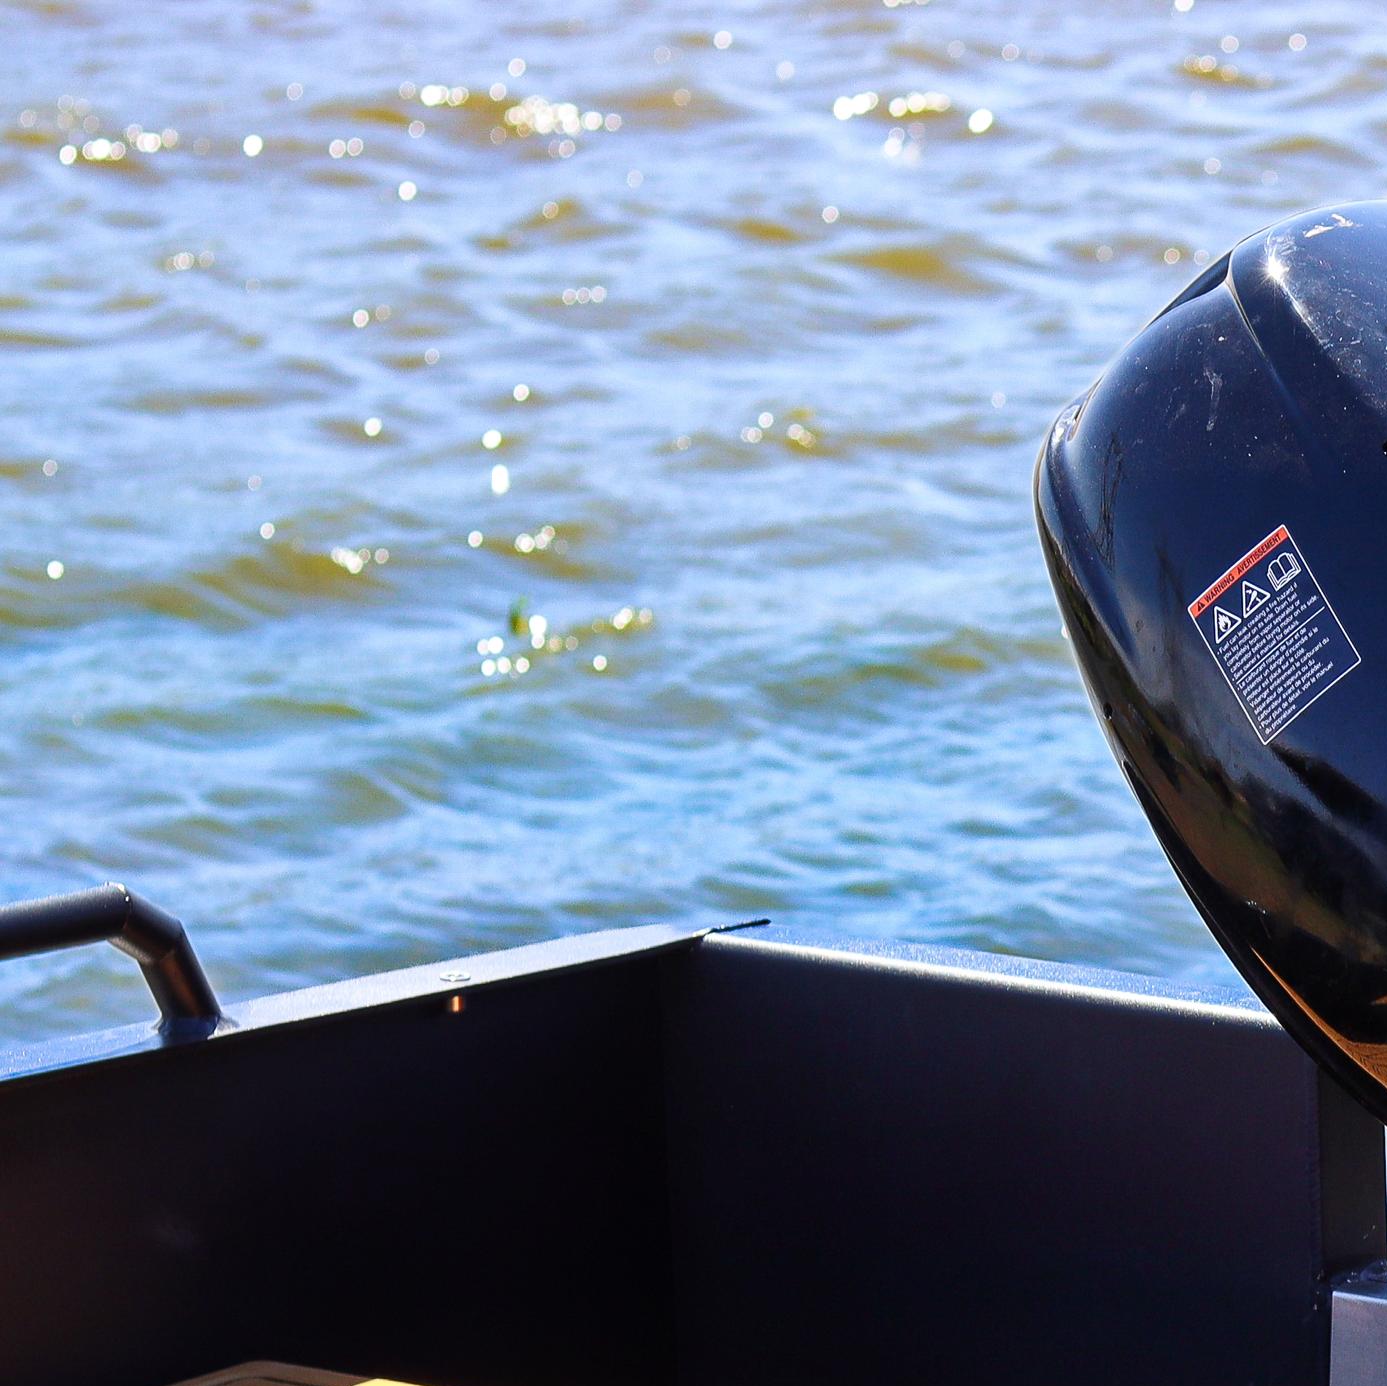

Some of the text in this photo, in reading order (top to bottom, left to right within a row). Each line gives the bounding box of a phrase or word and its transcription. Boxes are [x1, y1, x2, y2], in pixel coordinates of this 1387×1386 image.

[1203, 531, 1281, 603] WARNING AVERTISSEMENT
[1218, 640, 1230, 655] Fuel
[1228, 634, 1239, 645] can
[1276, 584, 1295, 603] hazard
[1222, 650, 1233, 662] you
[1238, 631, 1252, 647] motor
[1250, 626, 1259, 635] on
[1274, 600, 1289, 614] Drain
[1286, 591, 1298, 603] fuel
[1225, 599, 1301, 667] completely from vapor separator or
[1251, 637, 1267, 654] before
[1265, 625, 1281, 641] laying
[1279, 614, 1294, 629] motor
[1293, 608, 1302, 617] on
[1233, 668, 1244, 680] See
[1259, 637, 1277, 656] manual
[1275, 630, 1284, 642] for
[1238, 680, 1246, 690] Le
[1244, 661, 1267, 684] carburant
[1268, 654, 1286, 672] danger
[1299, 641, 1323, 664] carburant
[1260, 715, 1273, 729] Pour
